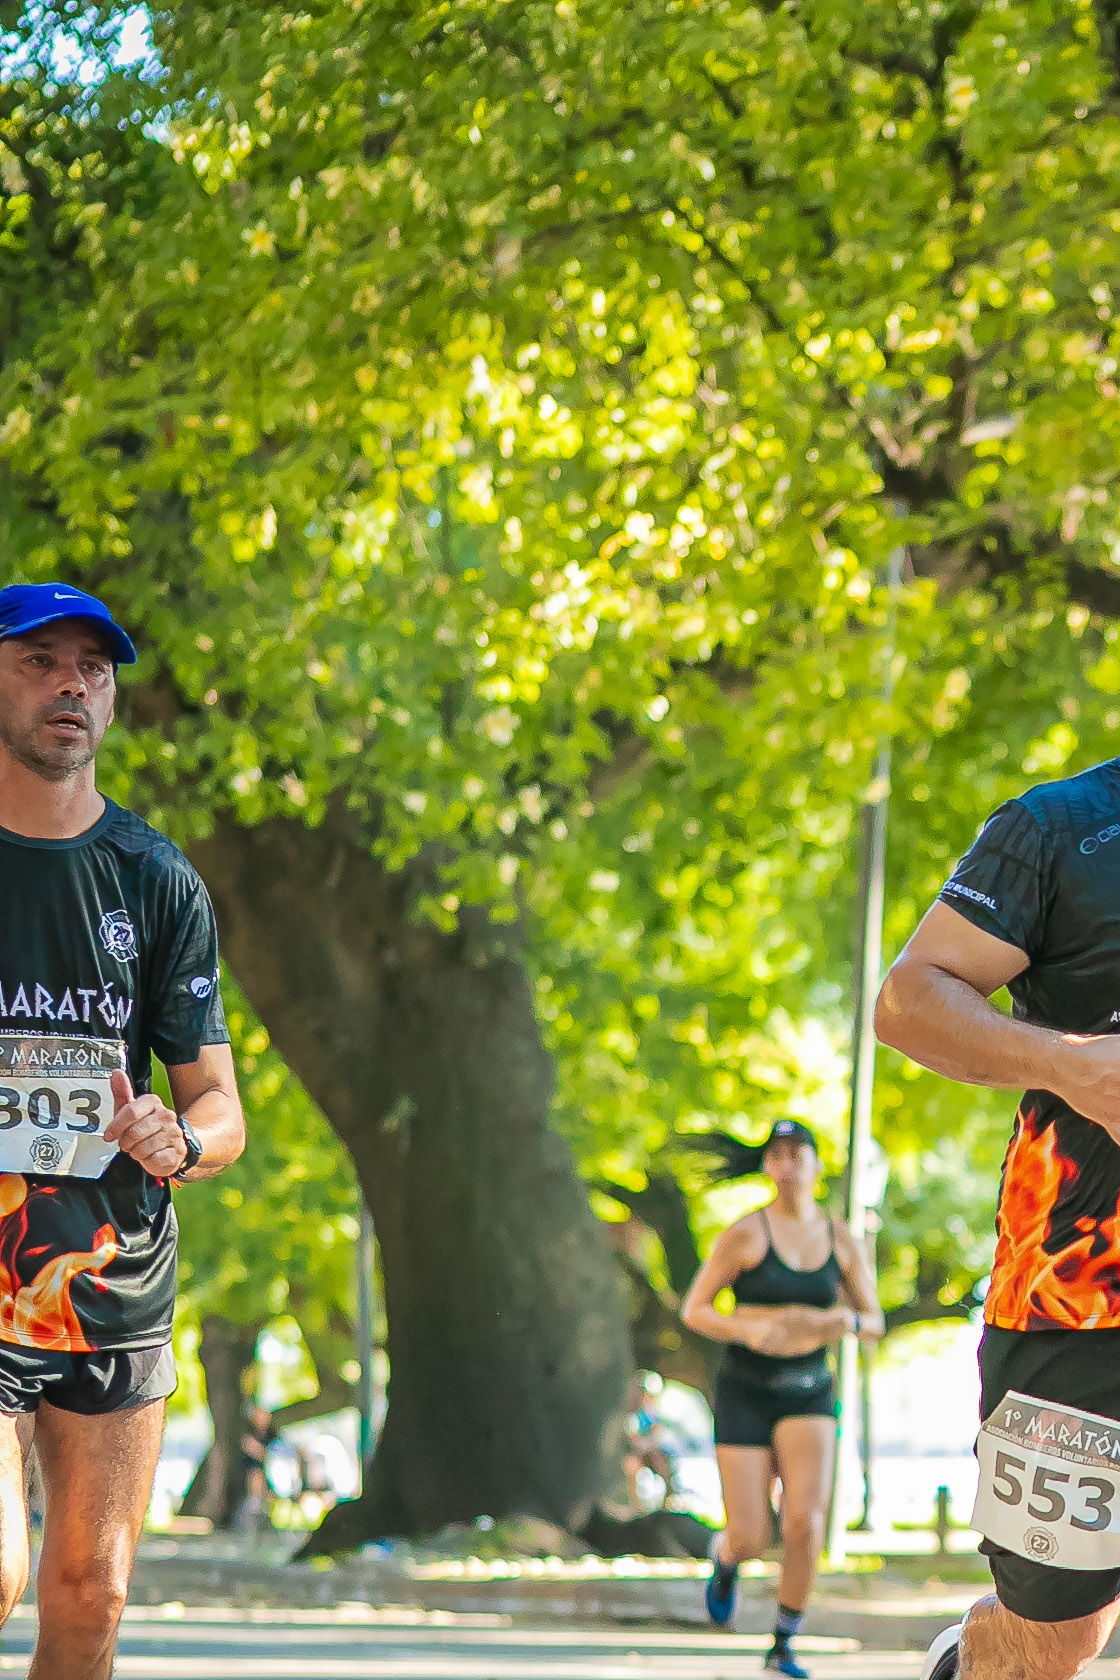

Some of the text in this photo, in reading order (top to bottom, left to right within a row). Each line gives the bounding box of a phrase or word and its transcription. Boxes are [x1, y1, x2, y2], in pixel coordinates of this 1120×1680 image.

[0, 981, 134, 1030] ARATÓN
[10, 1044, 103, 1066] MARATÓN
[992, 1450, 1116, 1532] 553
